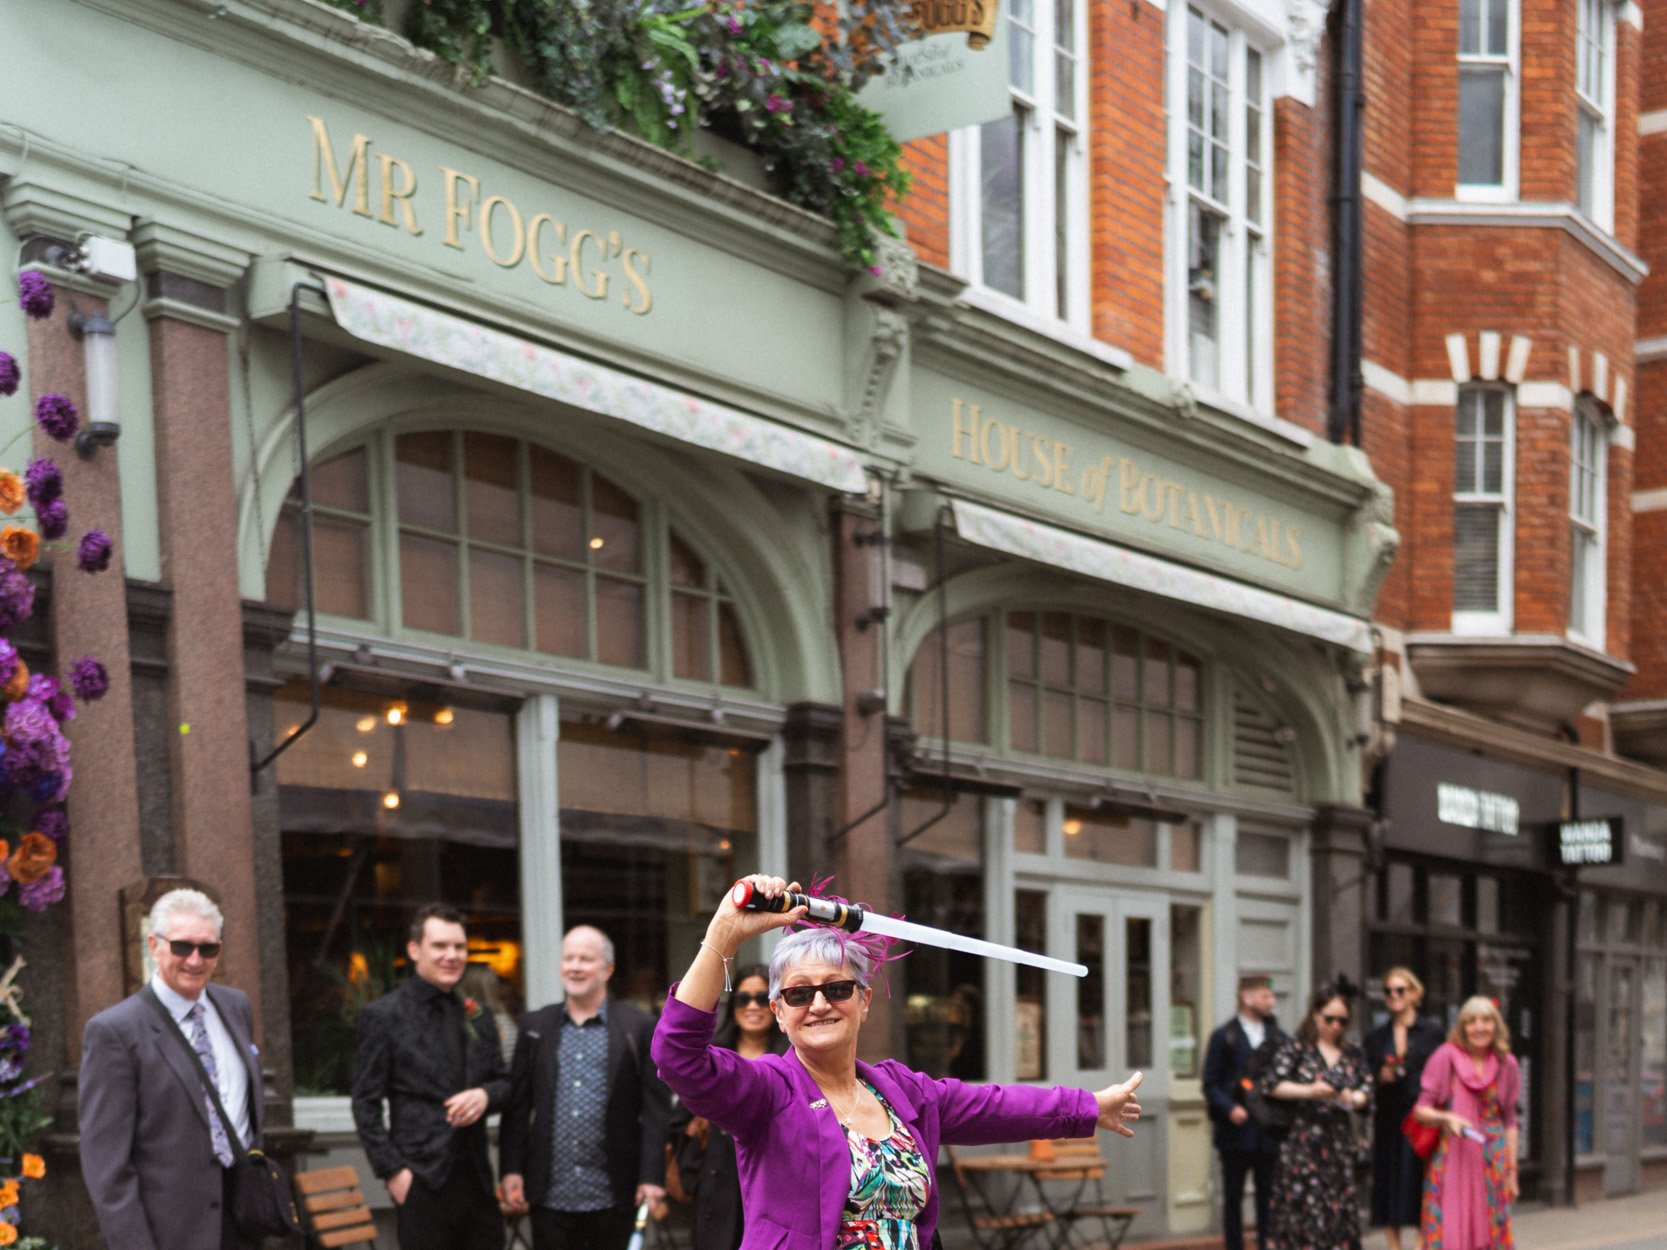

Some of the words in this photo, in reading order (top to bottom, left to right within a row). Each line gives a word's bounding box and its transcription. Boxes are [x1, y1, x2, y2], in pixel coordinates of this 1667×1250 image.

[306, 113, 424, 236] MR
[440, 165, 653, 315] FOGG'S
[952, 397, 1076, 495] HOUSE
[1081, 455, 1114, 514] of
[1119, 457, 1303, 571] BOTANICALS
